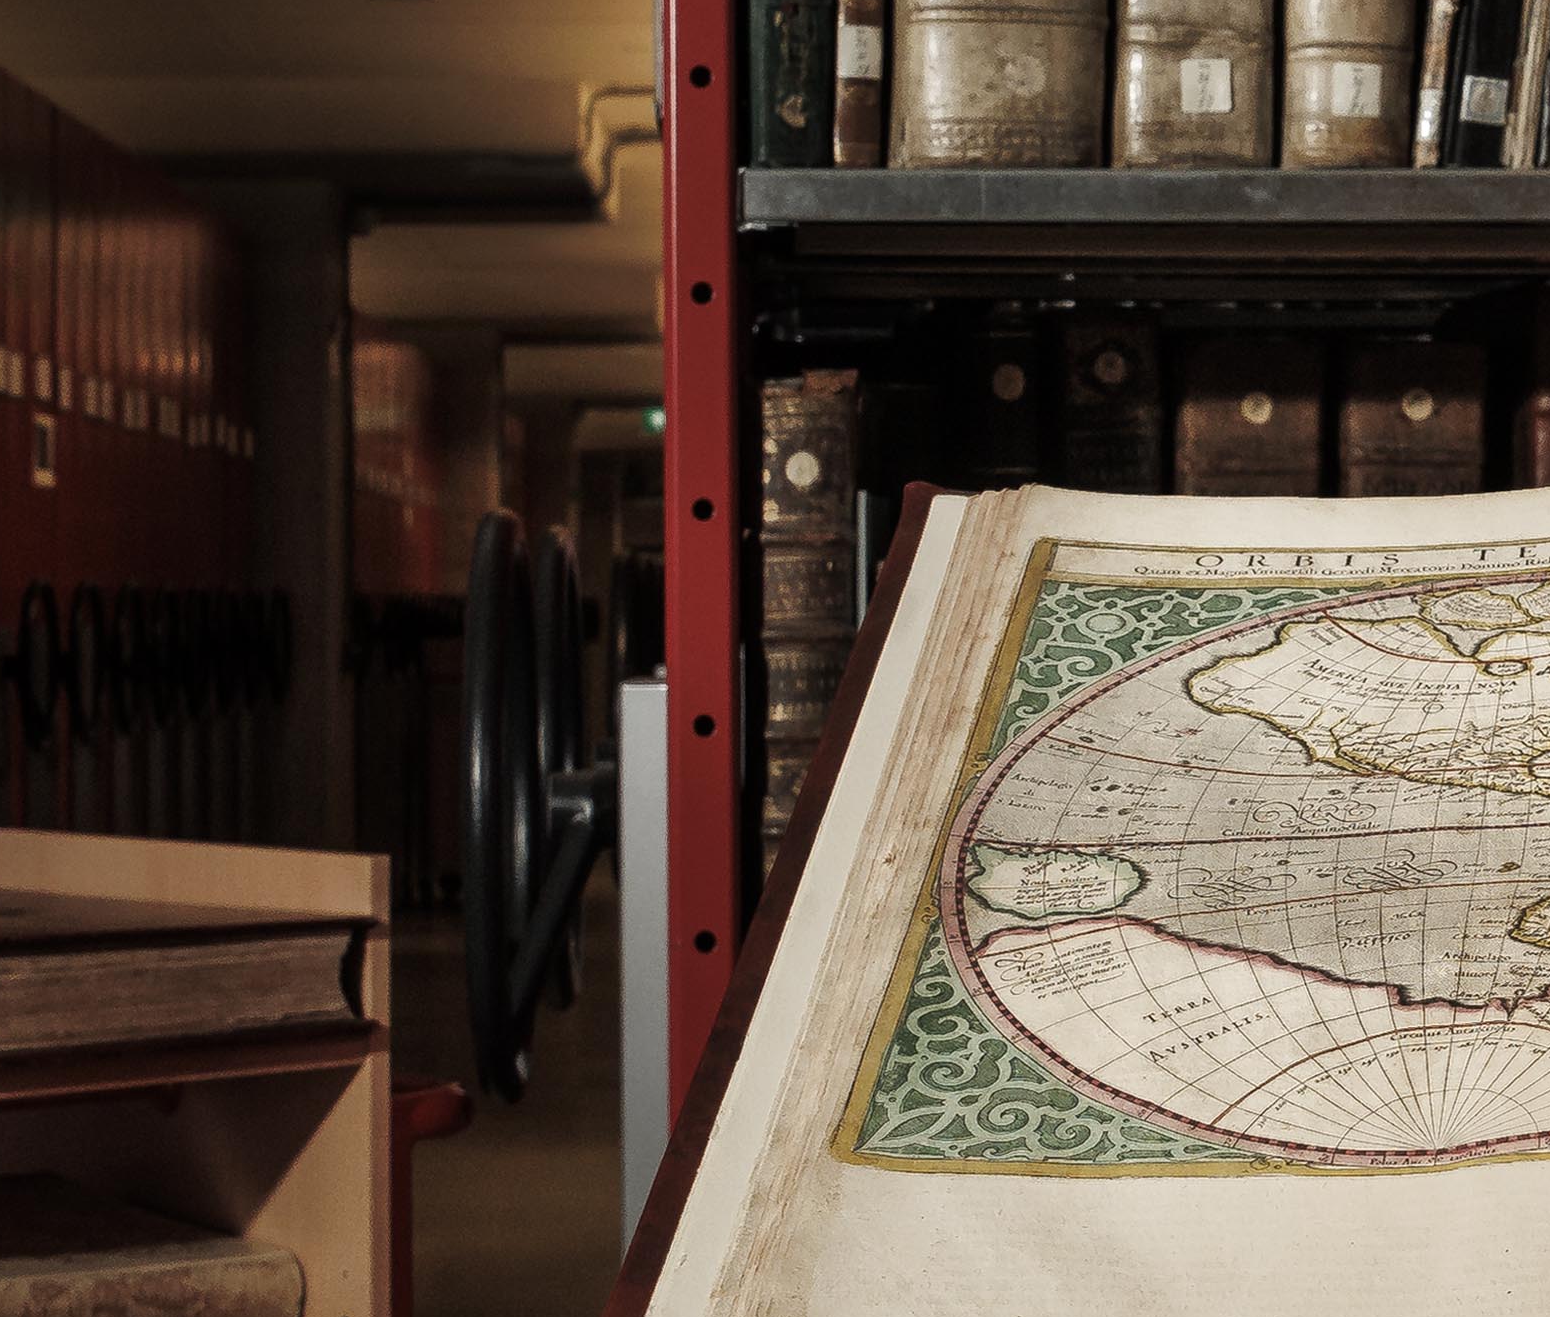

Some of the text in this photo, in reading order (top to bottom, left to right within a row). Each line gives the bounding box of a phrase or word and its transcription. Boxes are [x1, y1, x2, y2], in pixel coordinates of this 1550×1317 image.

[1194, 552, 1400, 568] ORBIS
[1302, 658, 1368, 684] AMERICA
[1475, 679, 1518, 689] NOVA
[1142, 996, 1212, 1024] TERRA
